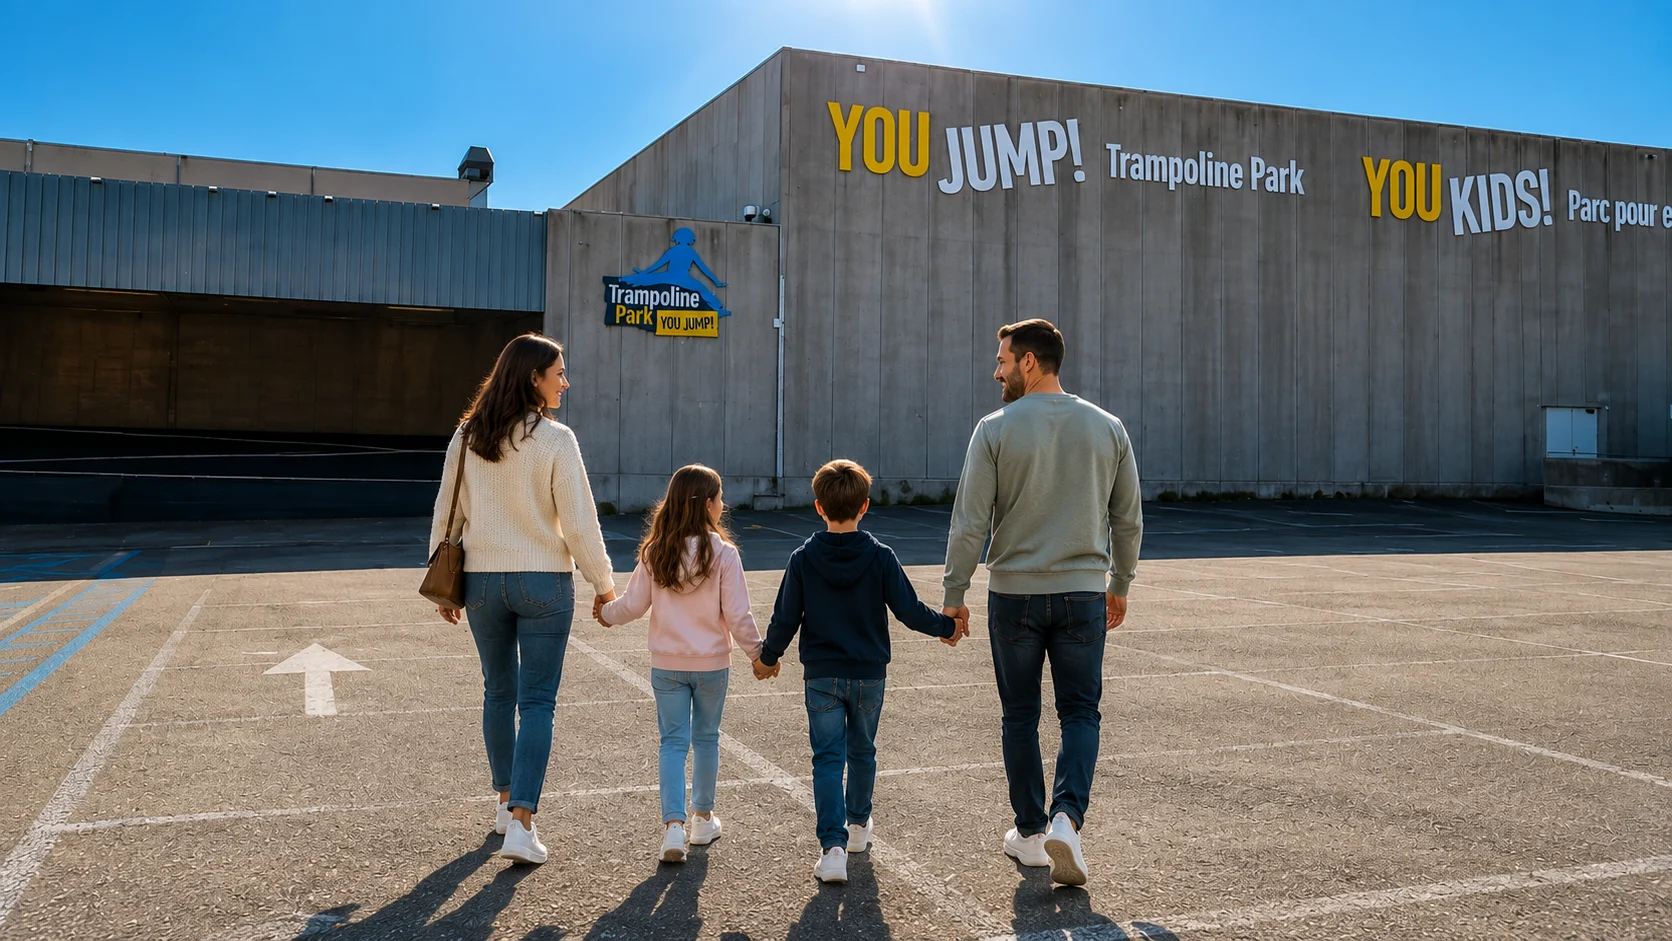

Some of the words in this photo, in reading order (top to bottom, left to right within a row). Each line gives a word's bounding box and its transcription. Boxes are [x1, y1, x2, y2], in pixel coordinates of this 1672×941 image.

[827, 101, 930, 177] YOU
[937, 118, 1086, 195] JUMP!
[1105, 143, 1244, 191] Trampoline
[1250, 156, 1305, 195] Park
[1361, 156, 1442, 222] YOU
[1448, 168, 1553, 236] KIDS!
[1568, 189, 1611, 224] Parc
[1614, 201, 1658, 232] pour
[608, 284, 700, 310] Trampoline
[615, 304, 653, 325] Park
[660, 316, 681, 330] YOU
[683, 316, 714, 331] JUMP!
